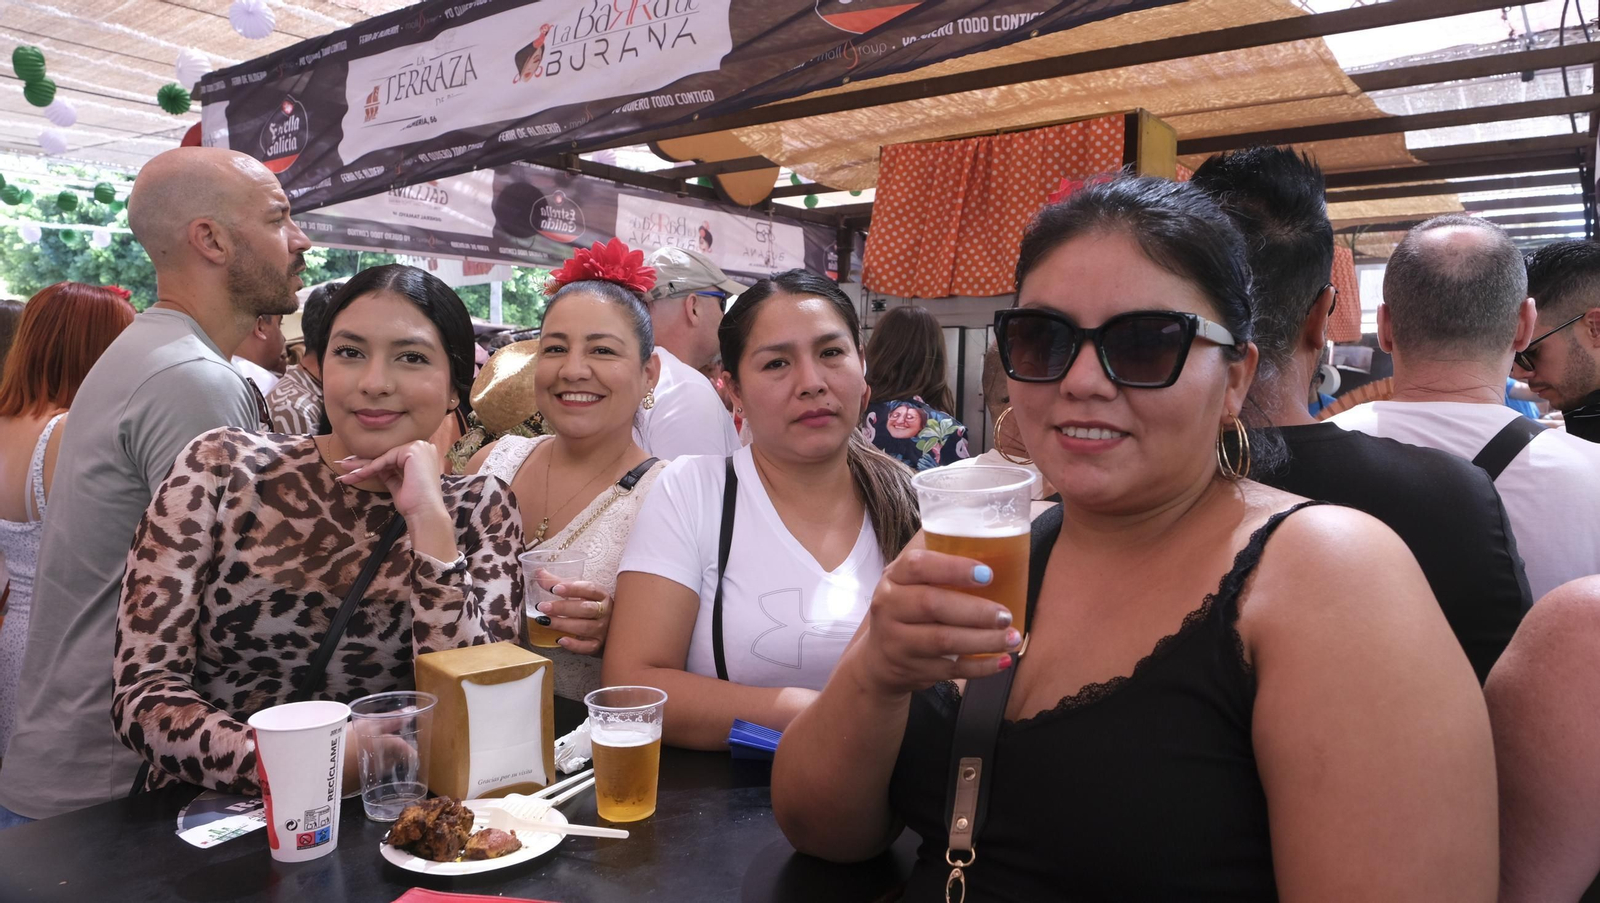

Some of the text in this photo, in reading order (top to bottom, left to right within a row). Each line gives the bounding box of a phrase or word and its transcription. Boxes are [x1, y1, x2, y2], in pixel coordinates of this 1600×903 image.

[957, 16, 990, 35] TODO
[545, 17, 697, 77] BURANA
[416, 56, 426, 66] LA
[385, 52, 478, 106] TERRAZA
[650, 95, 675, 109] TODO
[674, 89, 715, 106] CONTIGO
[517, 126, 528, 139] DE
[527, 122, 562, 138] ALMERIA
[340, 172, 356, 184] FERIA
[355, 170, 365, 180] DE
[477, 776, 500, 786] Gracias
[499, 773, 511, 782] por
